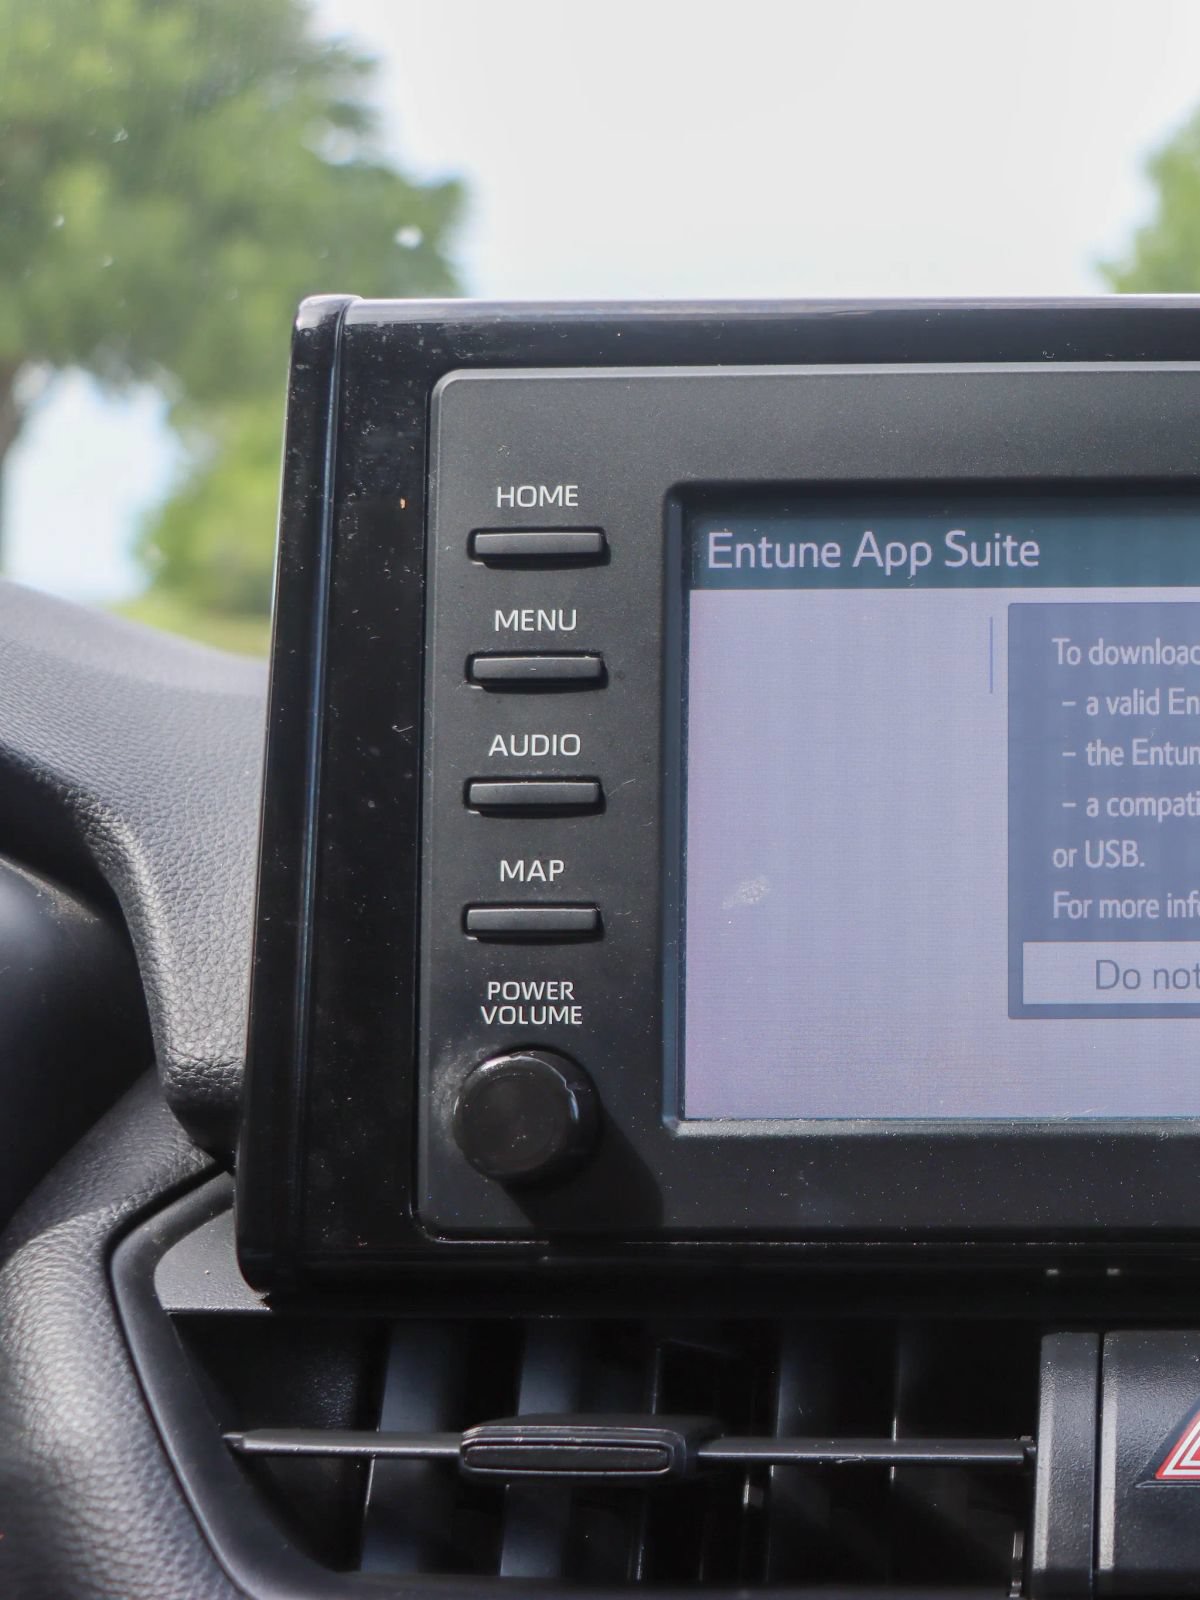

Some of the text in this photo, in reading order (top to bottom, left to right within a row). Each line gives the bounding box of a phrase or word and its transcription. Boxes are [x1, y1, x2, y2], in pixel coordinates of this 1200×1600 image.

[494, 484, 580, 509] HOME
[707, 530, 1041, 577] Entune App Suite
[493, 609, 578, 633] MENU
[1052, 637, 1083, 667] To
[1086, 696, 1100, 717] a
[1107, 687, 1161, 718] valid
[487, 733, 583, 758] AUDIO
[1086, 738, 1126, 768] the
[1086, 796, 1101, 819] a
[1052, 839, 1147, 870] or USB.
[499, 859, 567, 883] MAP
[1053, 890, 1094, 921] For
[1100, 898, 1161, 921] more
[1095, 959, 1143, 991] Do
[486, 981, 576, 1002] POWER
[480, 1004, 584, 1027] VOLUME
